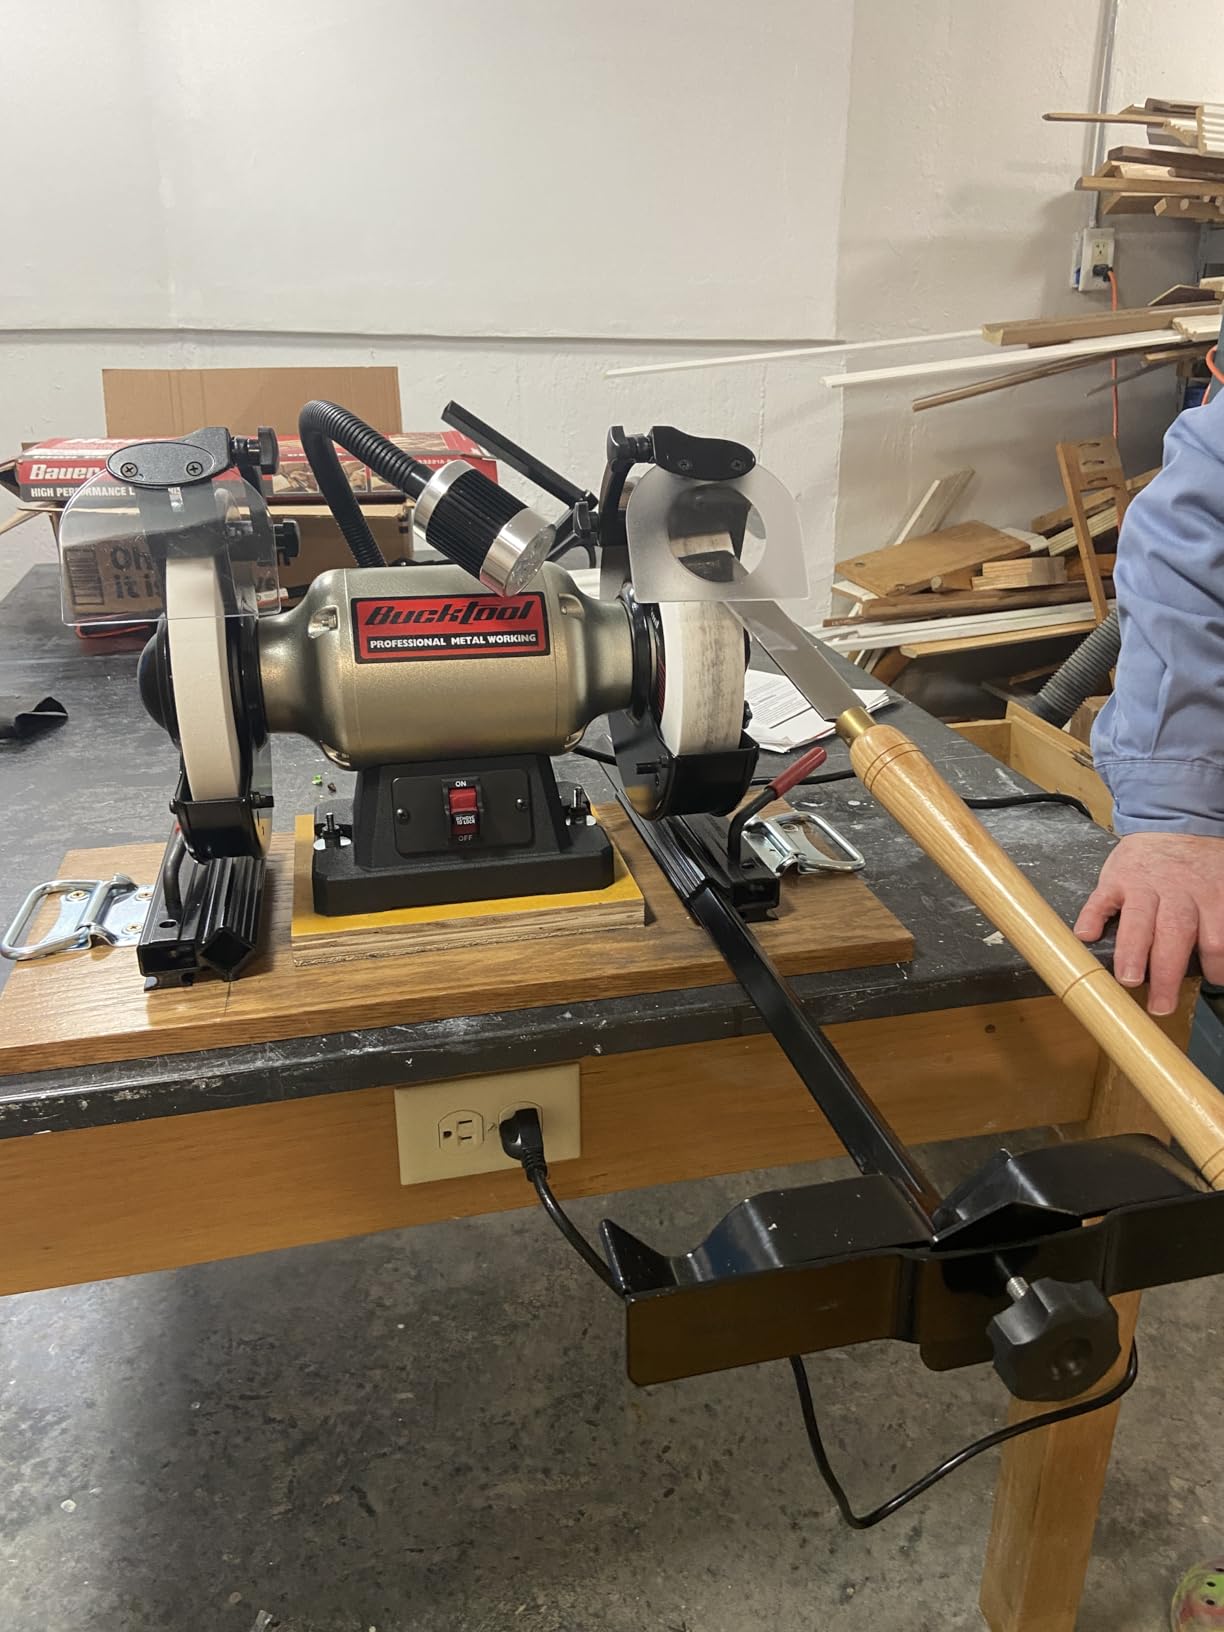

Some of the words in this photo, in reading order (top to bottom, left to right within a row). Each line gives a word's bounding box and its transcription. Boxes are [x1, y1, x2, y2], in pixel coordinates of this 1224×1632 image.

[29, 464, 101, 480] Bauer
[30, 487, 55, 497] HIGH
[113, 573, 140, 599] it
[370, 638, 446, 649] PROFESSIONAL
[450, 635, 486, 646] METAL
[487, 633, 537, 644] WORKING
[455, 780, 467, 788] ON
